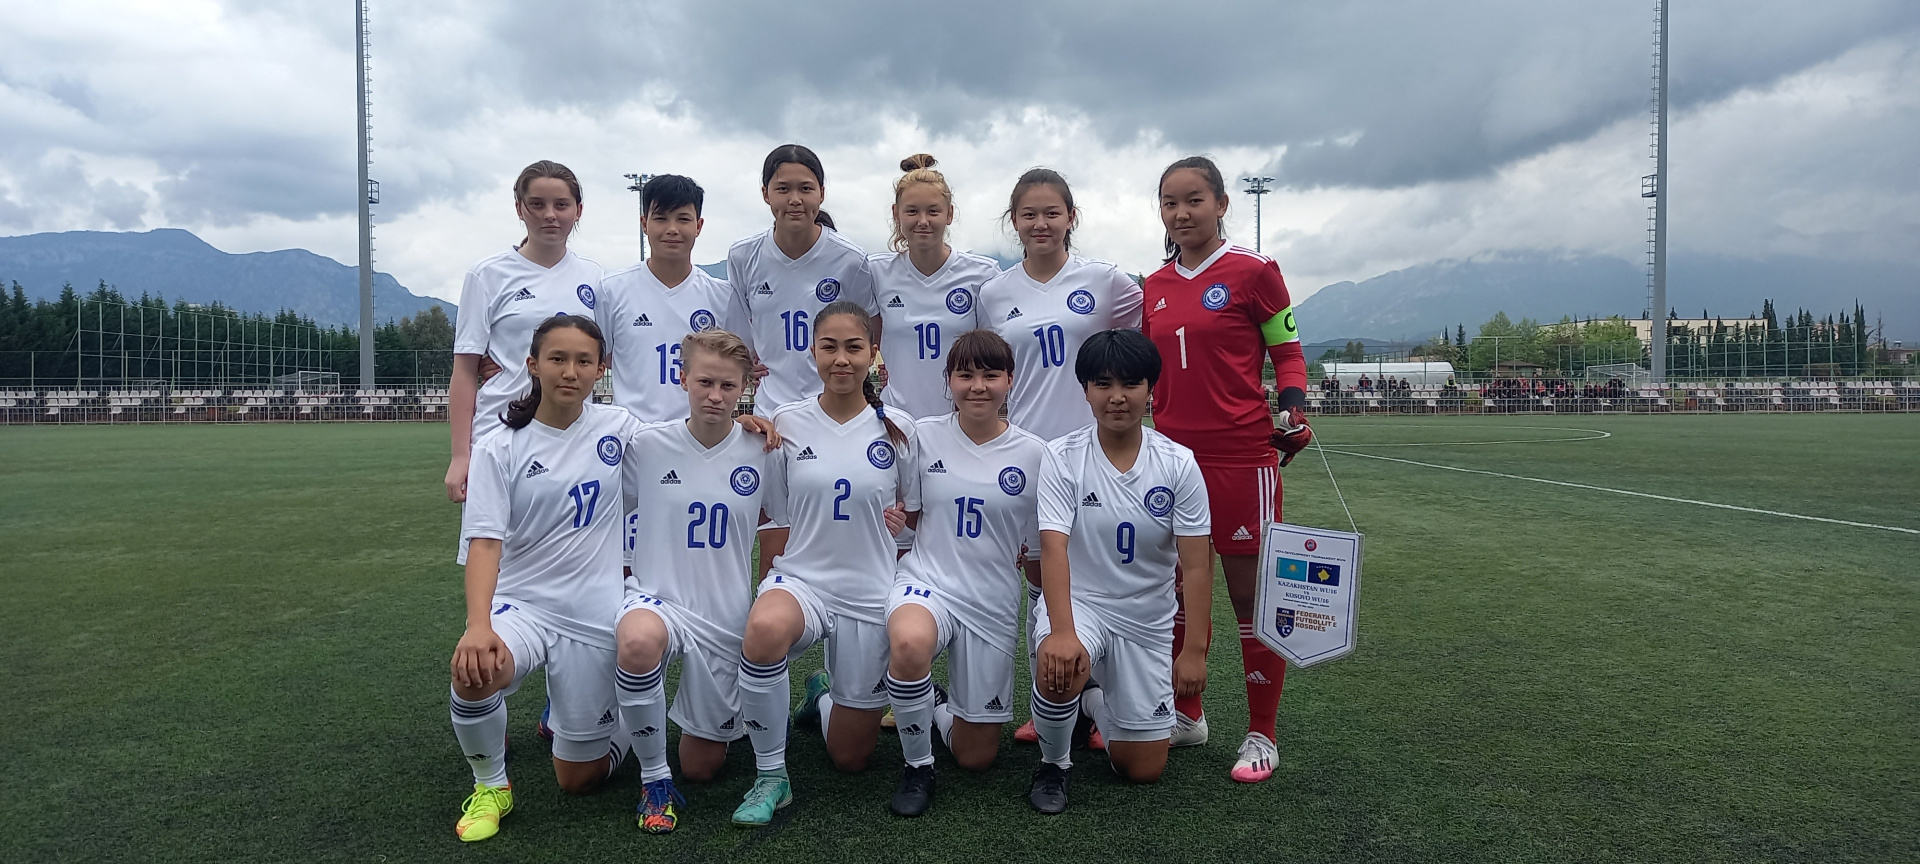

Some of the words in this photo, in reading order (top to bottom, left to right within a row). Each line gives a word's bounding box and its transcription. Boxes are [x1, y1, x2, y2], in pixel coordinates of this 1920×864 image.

[780, 310, 809, 352] 16
[1006, 313, 1023, 321] adidas
[1284, 312, 1296, 332] C
[914, 322, 941, 360] 19
[1033, 324, 1065, 369] 10
[1175, 326, 1188, 370] 1
[655, 342, 684, 385] 13
[526, 468, 550, 479] adidas
[568, 480, 600, 528] 17
[834, 479, 851, 521] 2
[954, 496, 985, 539] 15
[687, 501, 729, 549] 20
[1116, 521, 1136, 564] 9
[1277, 580, 1318, 592] KAZAKHSTAN
[1285, 591, 1311, 601] KOSOVO
[1295, 616, 1333, 627] FUTBOLLIT
[1296, 610, 1331, 621] FEDERATA
